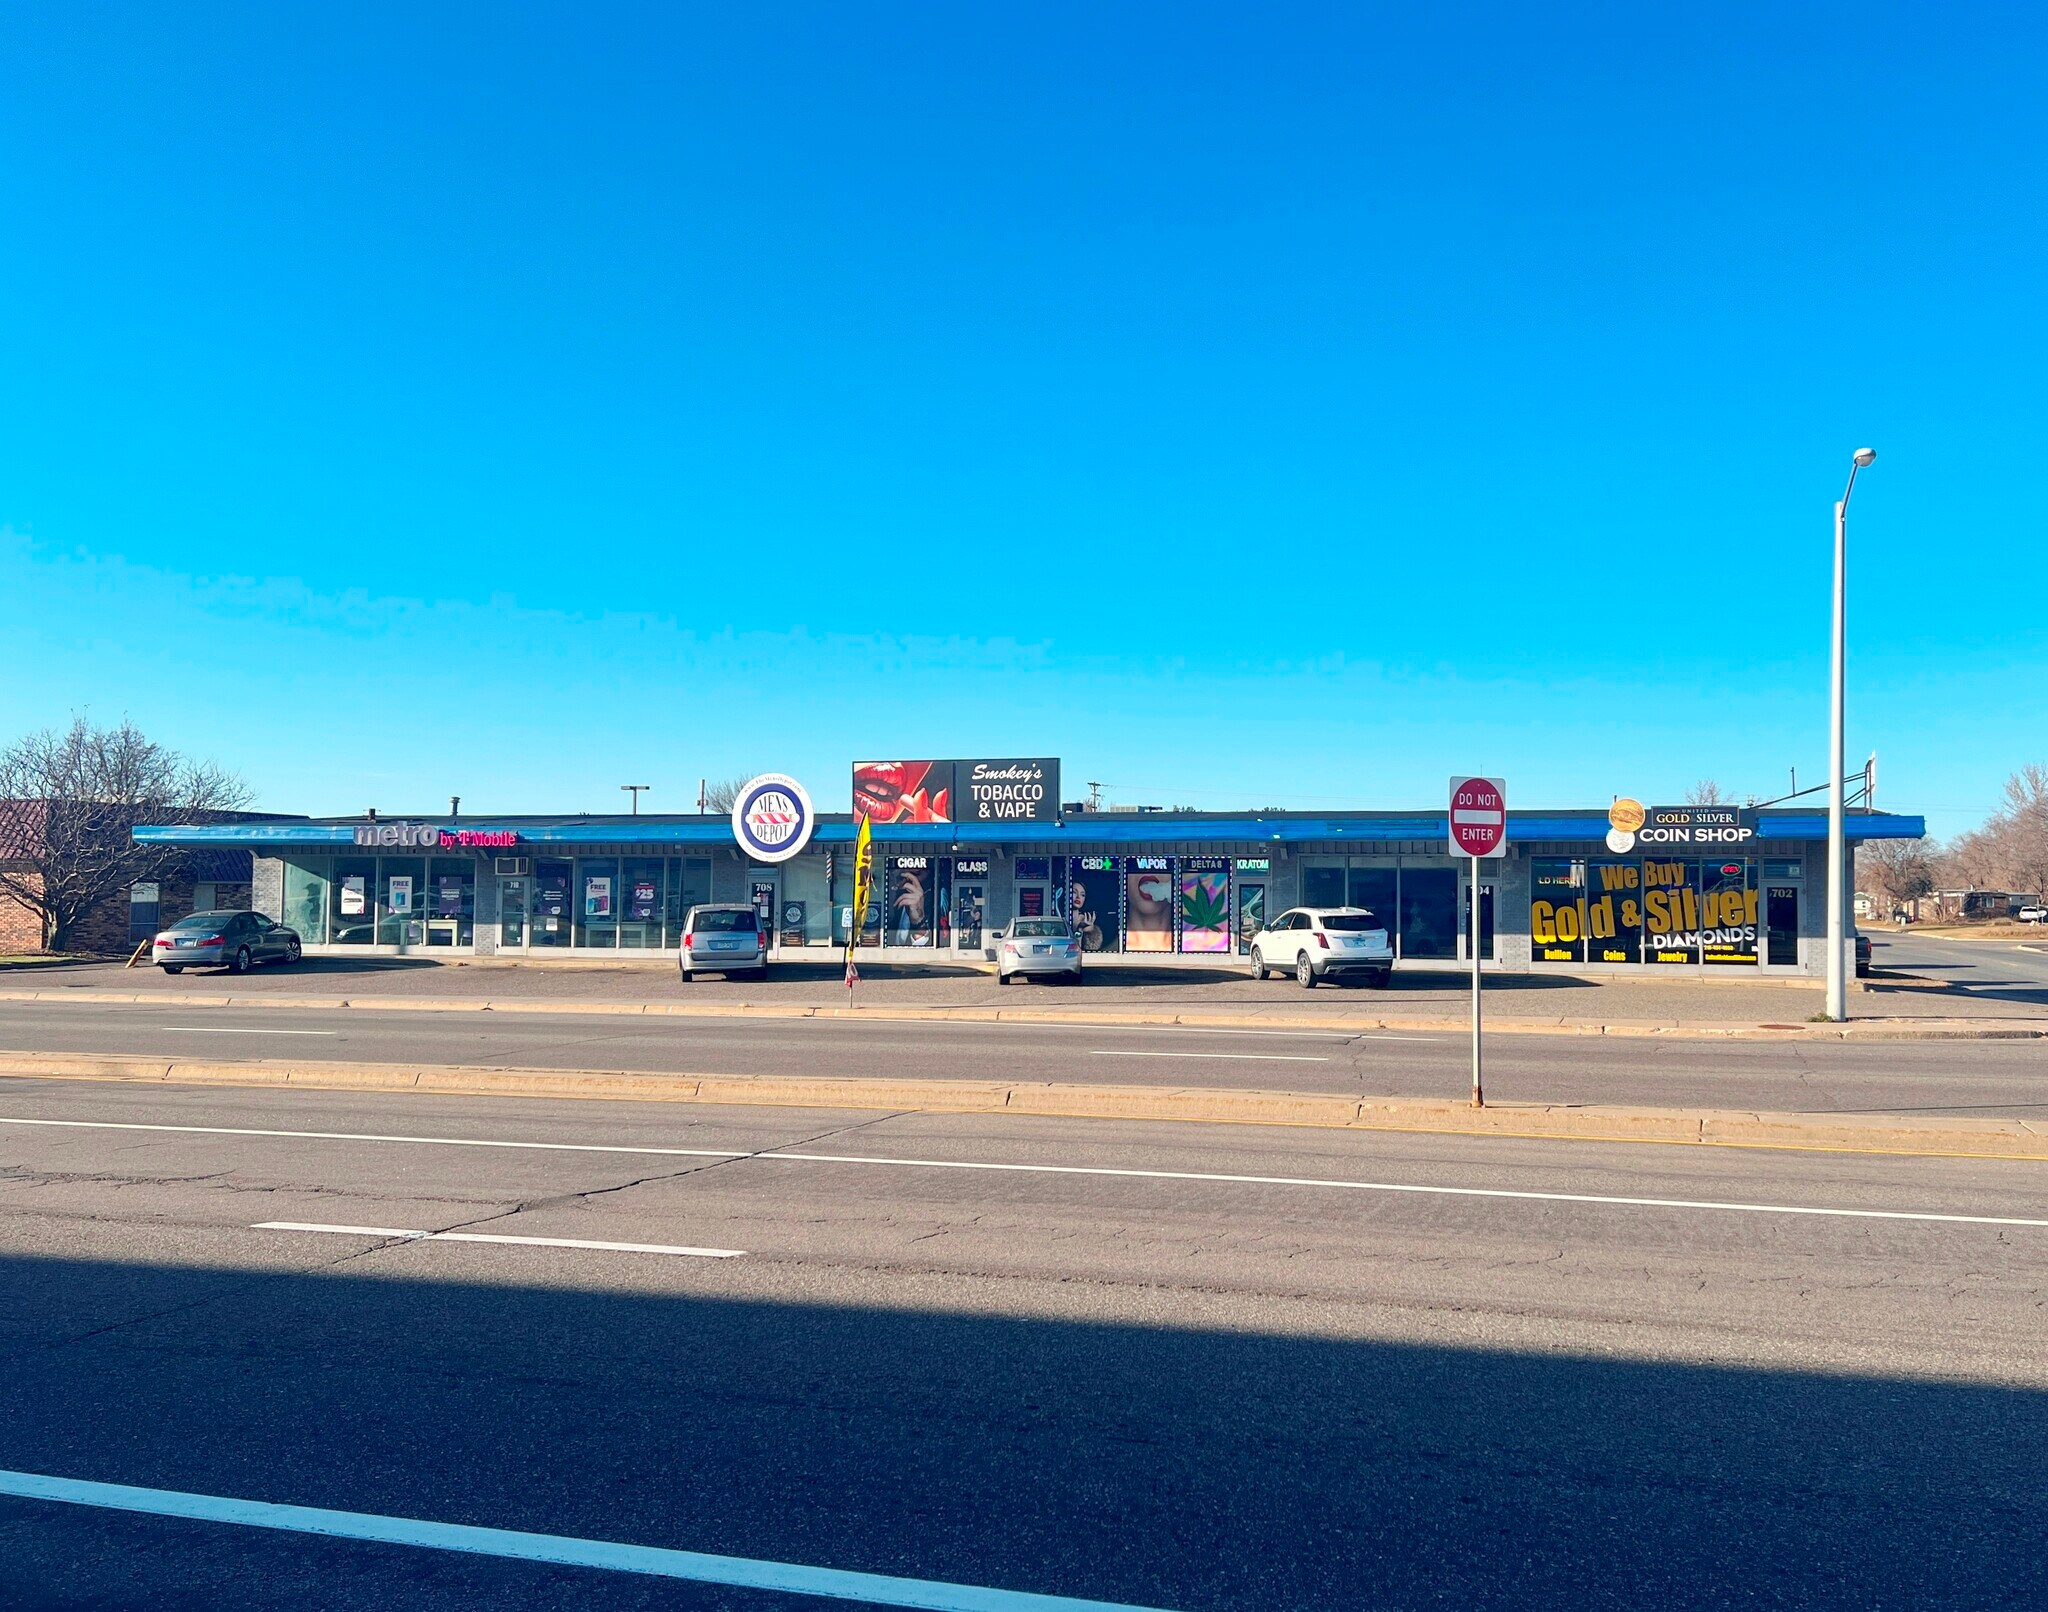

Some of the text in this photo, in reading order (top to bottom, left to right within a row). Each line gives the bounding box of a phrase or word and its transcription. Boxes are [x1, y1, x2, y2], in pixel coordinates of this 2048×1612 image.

[971, 763, 1042, 783] Smokey's
[971, 784, 1043, 800] TOBACCO
[1459, 793, 1496, 806] DO NOT
[978, 802, 1036, 818] & VAPE
[1656, 813, 1690, 823] GOLD
[1696, 813, 1734, 823] SILVER
[353, 821, 439, 847] metro
[440, 831, 456, 850] by
[756, 824, 789, 842] DEPOT
[1462, 828, 1494, 841] ENTER
[1639, 828, 1752, 842] COIN SHOP
[897, 857, 927, 869] CIGAR
[957, 861, 988, 872] GLASS
[1137, 858, 1167, 870] VAPOR
[1191, 860, 1222, 869] DELTA 8
[1237, 859, 1269, 869] KRATOM
[1599, 861, 1685, 891] We Buy
[755, 883, 772, 892] 708
[1771, 889, 1793, 898] 702
[635, 888, 654, 900] $25
[1531, 887, 1758, 945] Gold & Silver
[1652, 926, 1755, 950] DIAMONDS
[1544, 949, 1572, 960] Bullion
[1603, 949, 1626, 961] Coins
[1657, 951, 1688, 963] Jewelry
